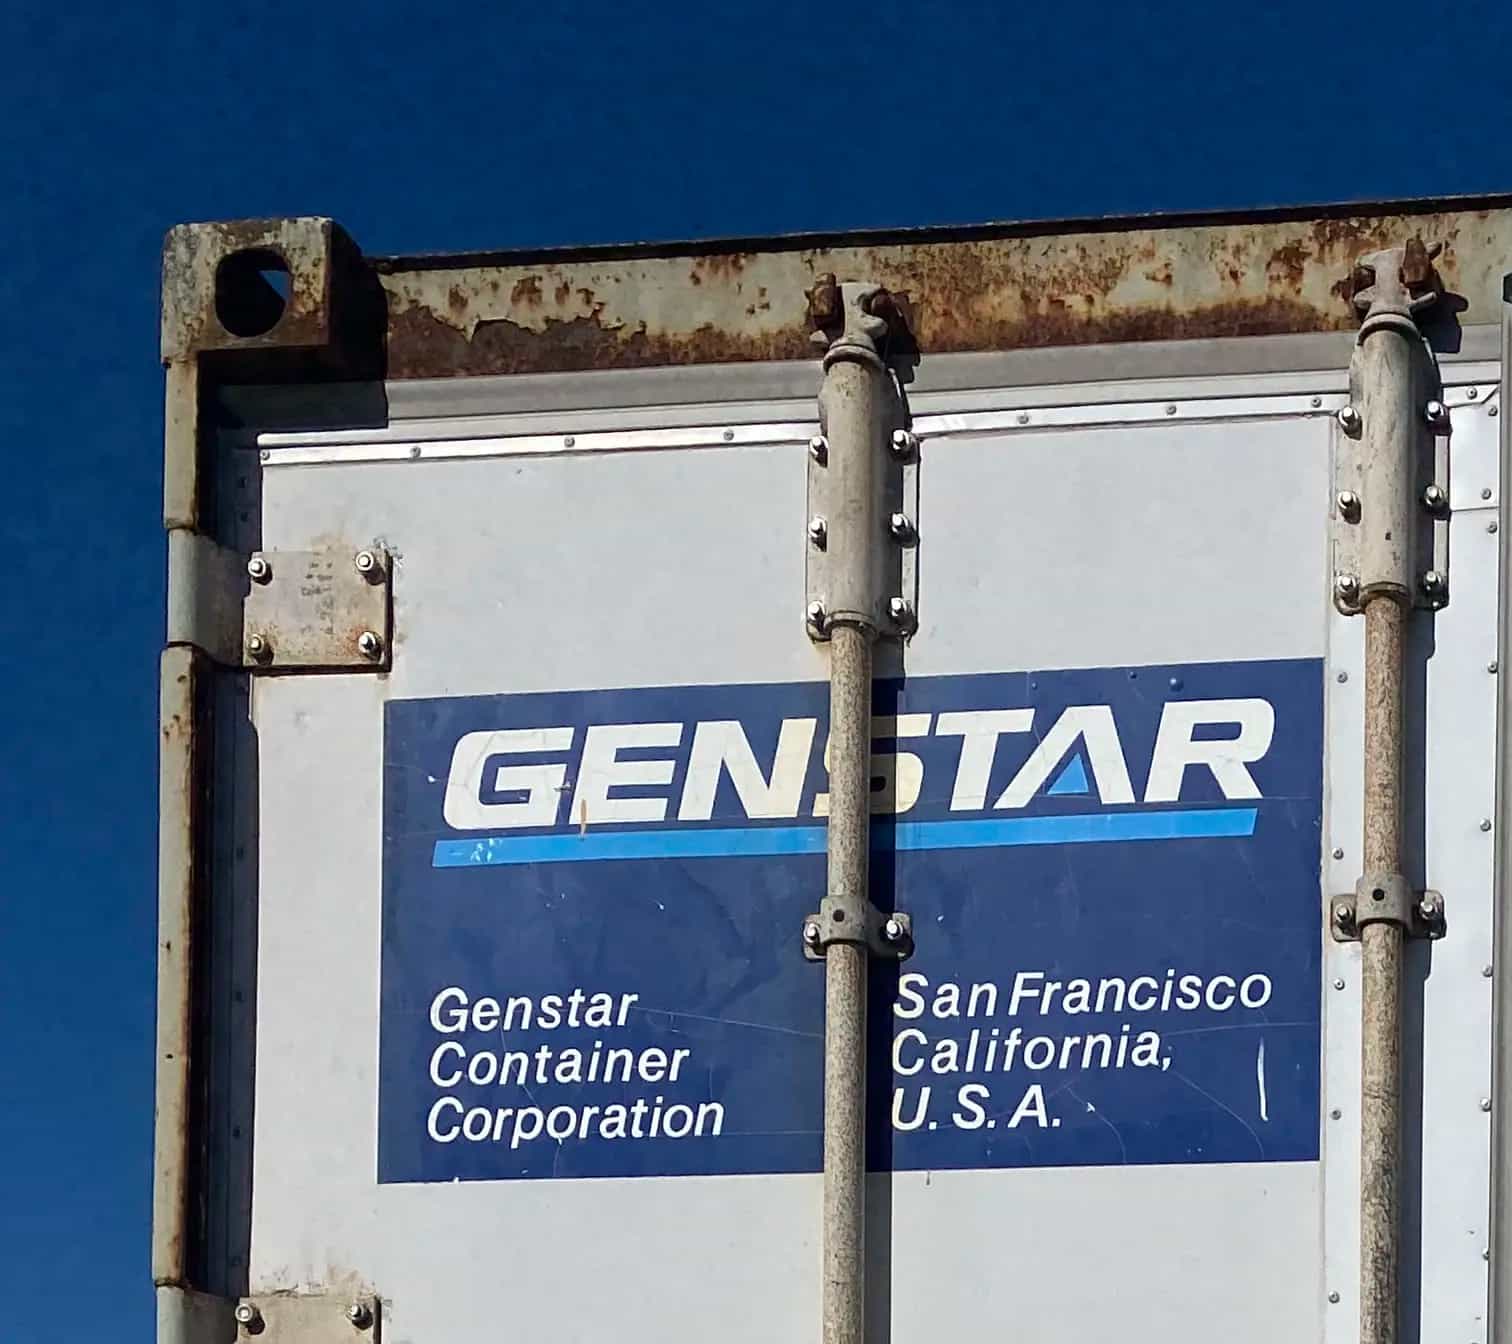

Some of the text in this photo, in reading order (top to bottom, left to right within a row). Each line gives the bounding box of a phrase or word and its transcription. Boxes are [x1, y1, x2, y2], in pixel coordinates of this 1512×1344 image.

[441, 697, 1276, 832] GENSTAR
[429, 986, 639, 1034] Genstar
[892, 970, 1274, 1021] San Francisco
[428, 1040, 689, 1089] Container
[890, 1024, 1174, 1077] California,
[426, 1096, 725, 1149] Corporation
